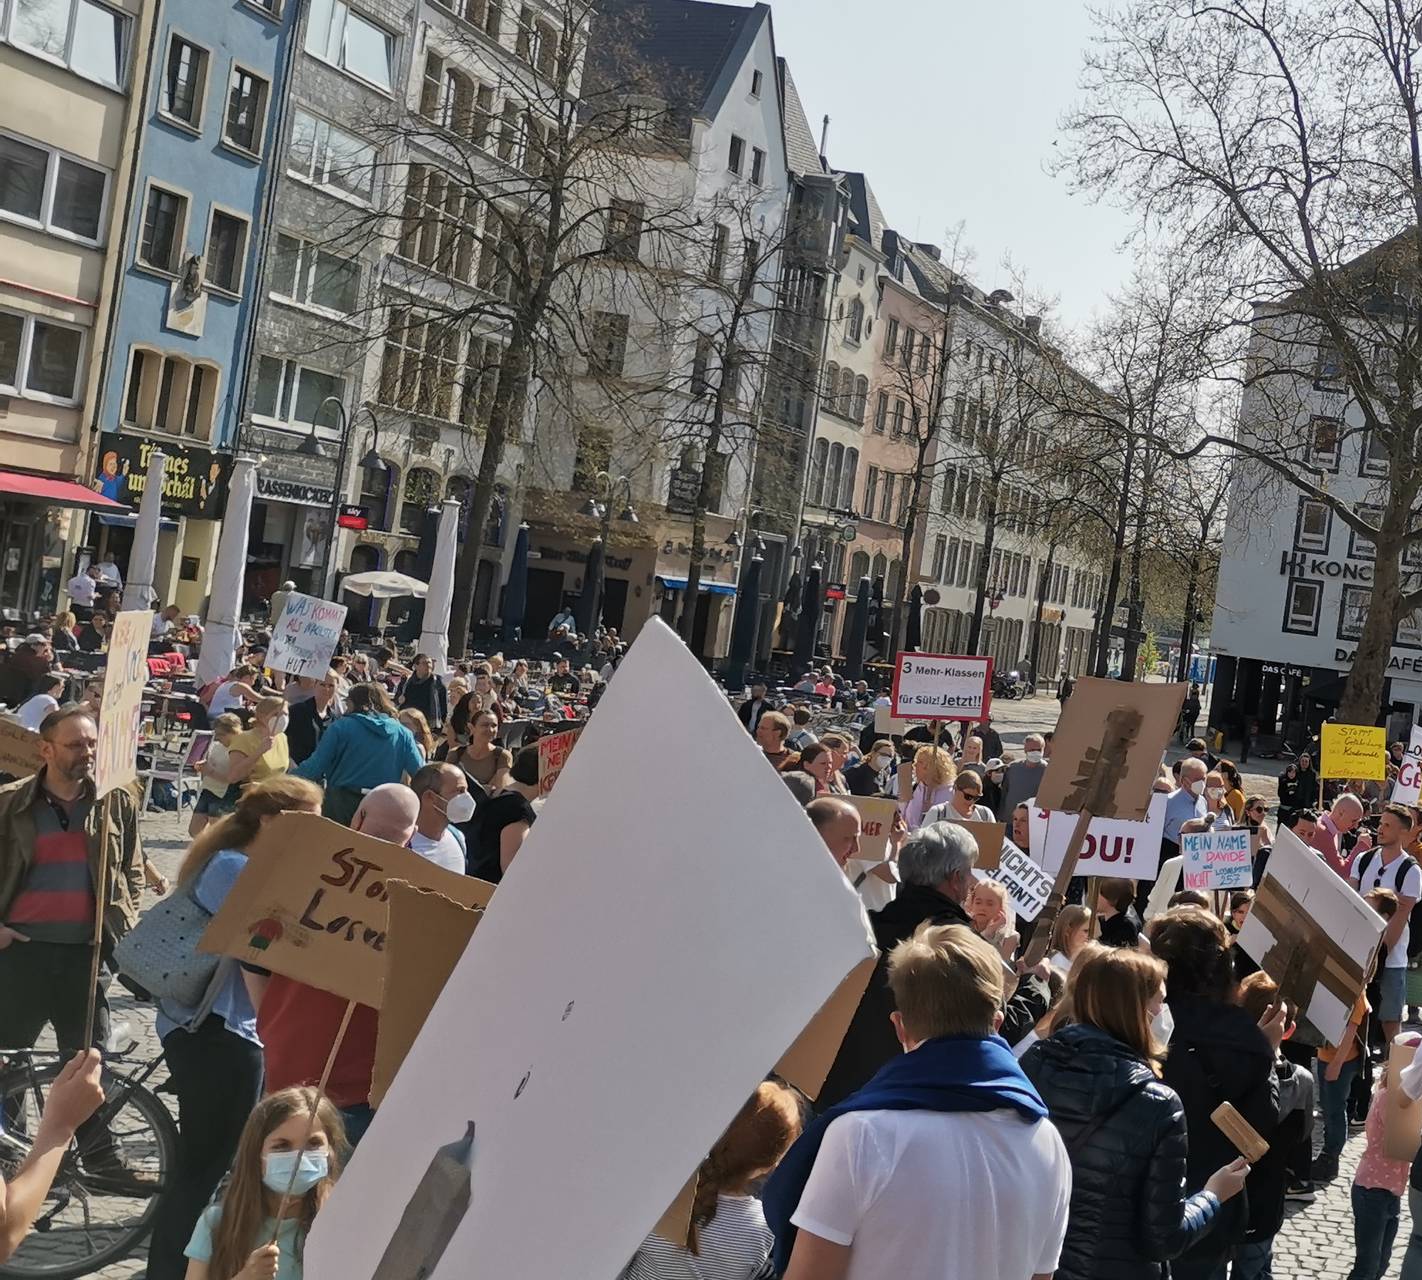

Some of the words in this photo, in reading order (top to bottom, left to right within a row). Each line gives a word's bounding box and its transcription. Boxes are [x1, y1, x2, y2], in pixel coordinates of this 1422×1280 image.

[347, 508, 361, 517] sky
[286, 598, 310, 616] WAS
[902, 661, 912, 674] 3
[915, 665, 985, 678] Mehr-Klassen
[1262, 664, 1279, 674] DAS
[898, 695, 913, 704] für
[915, 695, 940, 705] Sülz!
[940, 694, 982, 707] Jetzt!!
[1079, 833, 1135, 863] DU!
[1184, 835, 1212, 851] MEIN
[1217, 834, 1247, 850] NAME
[1206, 851, 1247, 863] DAVIDE
[1186, 871, 1212, 888] NICHT
[1220, 874, 1241, 886] 257
[985, 869, 1040, 913] ELERNT!
